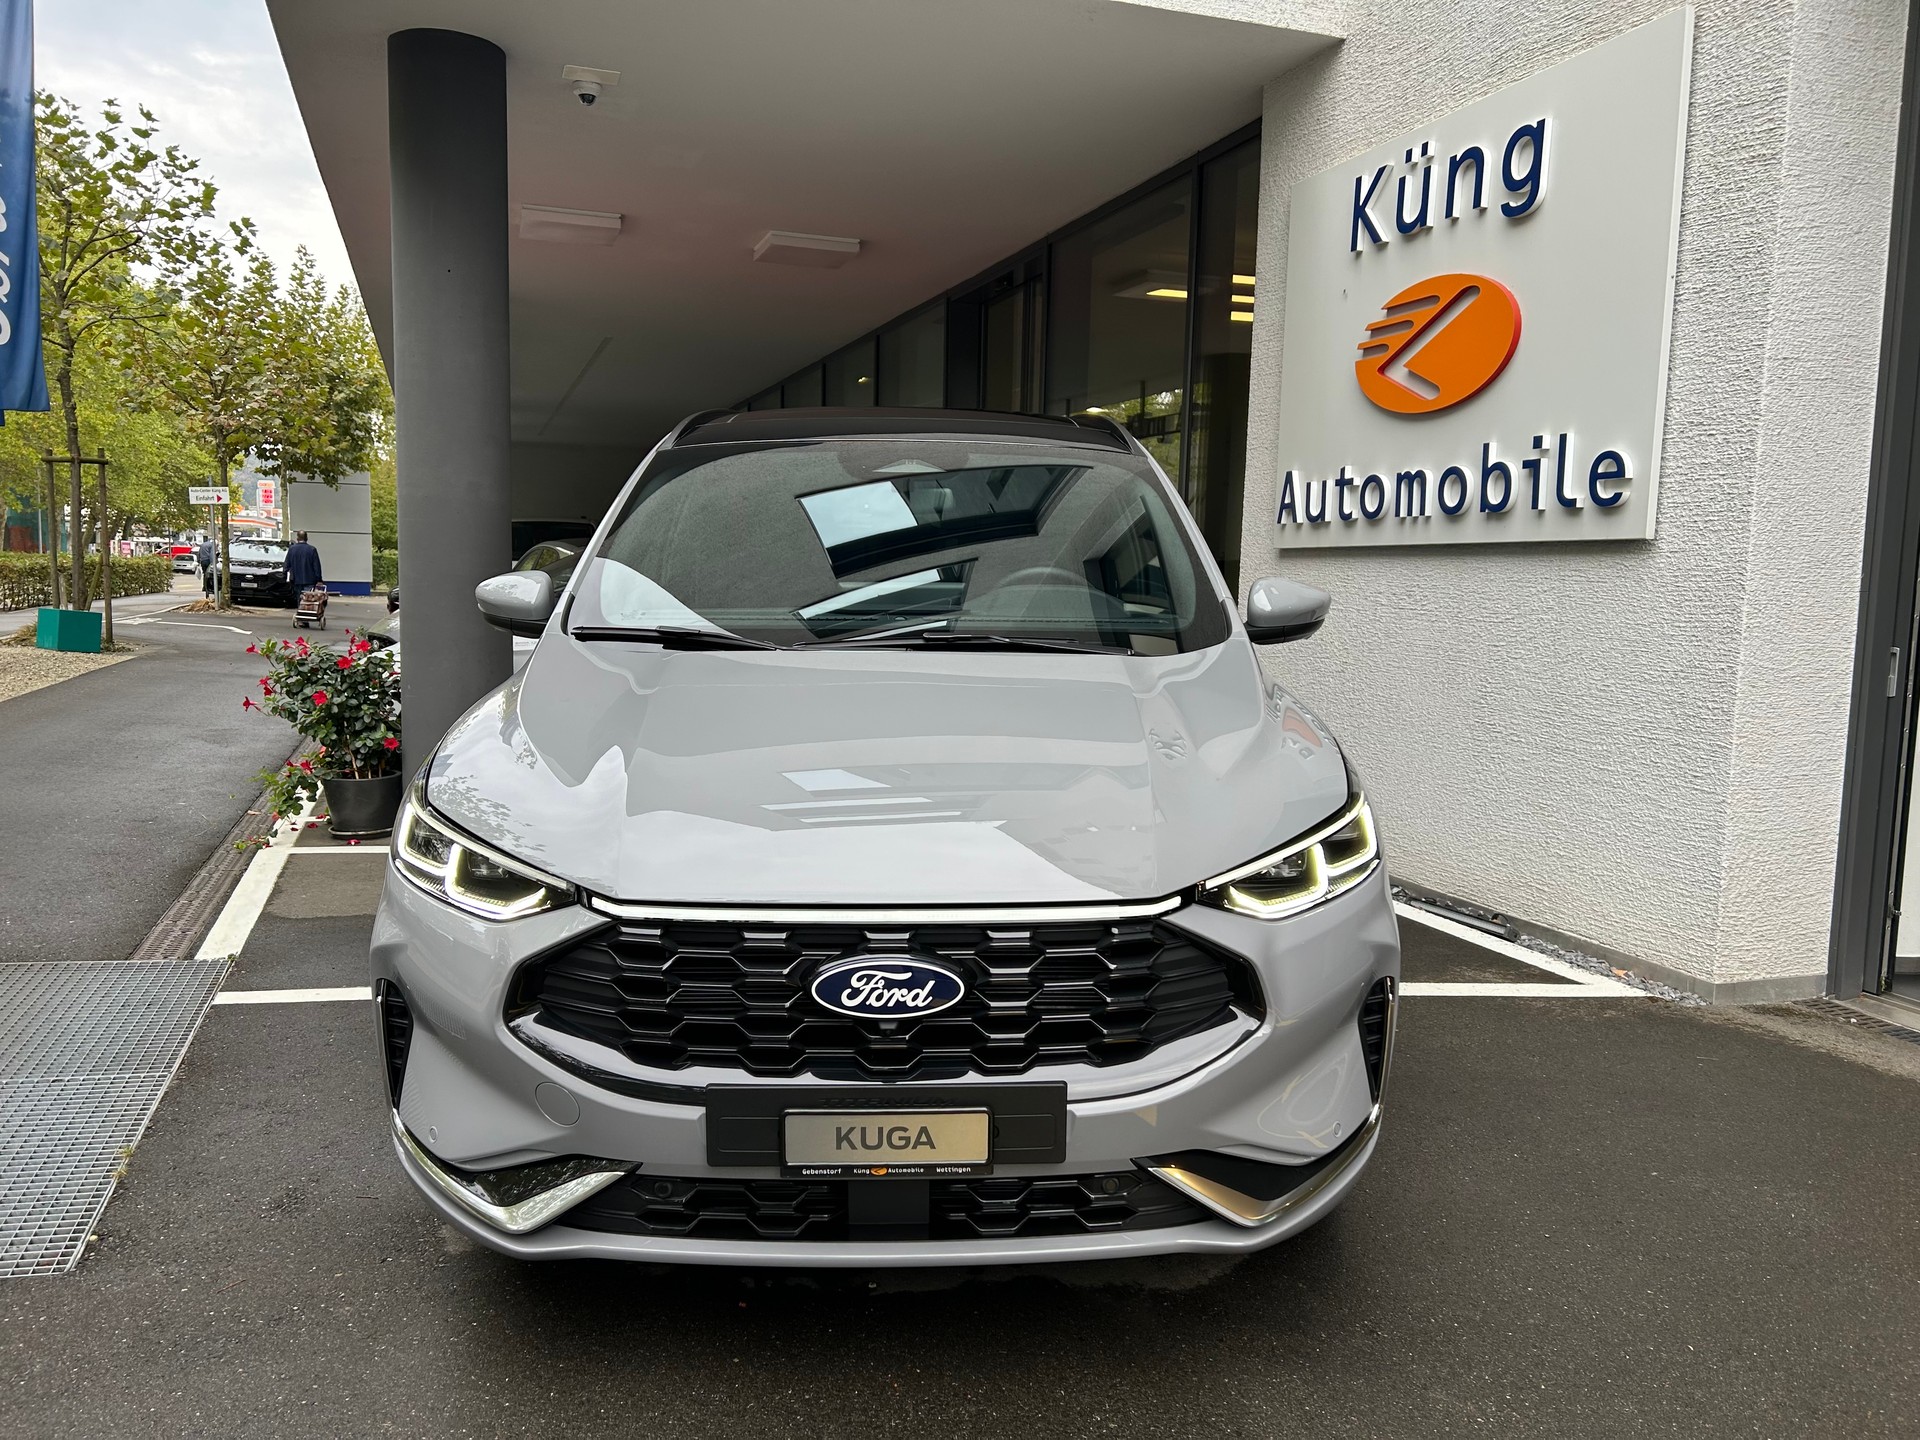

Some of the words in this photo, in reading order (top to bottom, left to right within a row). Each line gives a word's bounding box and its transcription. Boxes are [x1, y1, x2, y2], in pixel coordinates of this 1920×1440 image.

[1350, 117, 1552, 252] Küng
[1277, 432, 1633, 525] Automobile
[840, 970, 936, 1008] Ford
[835, 1126, 936, 1151] KUGA
[802, 1167, 842, 1176] Gebenstorf
[853, 1167, 870, 1176] Küng
[888, 1166, 925, 1174] Automobile
[936, 1166, 971, 1174] Wettingen
